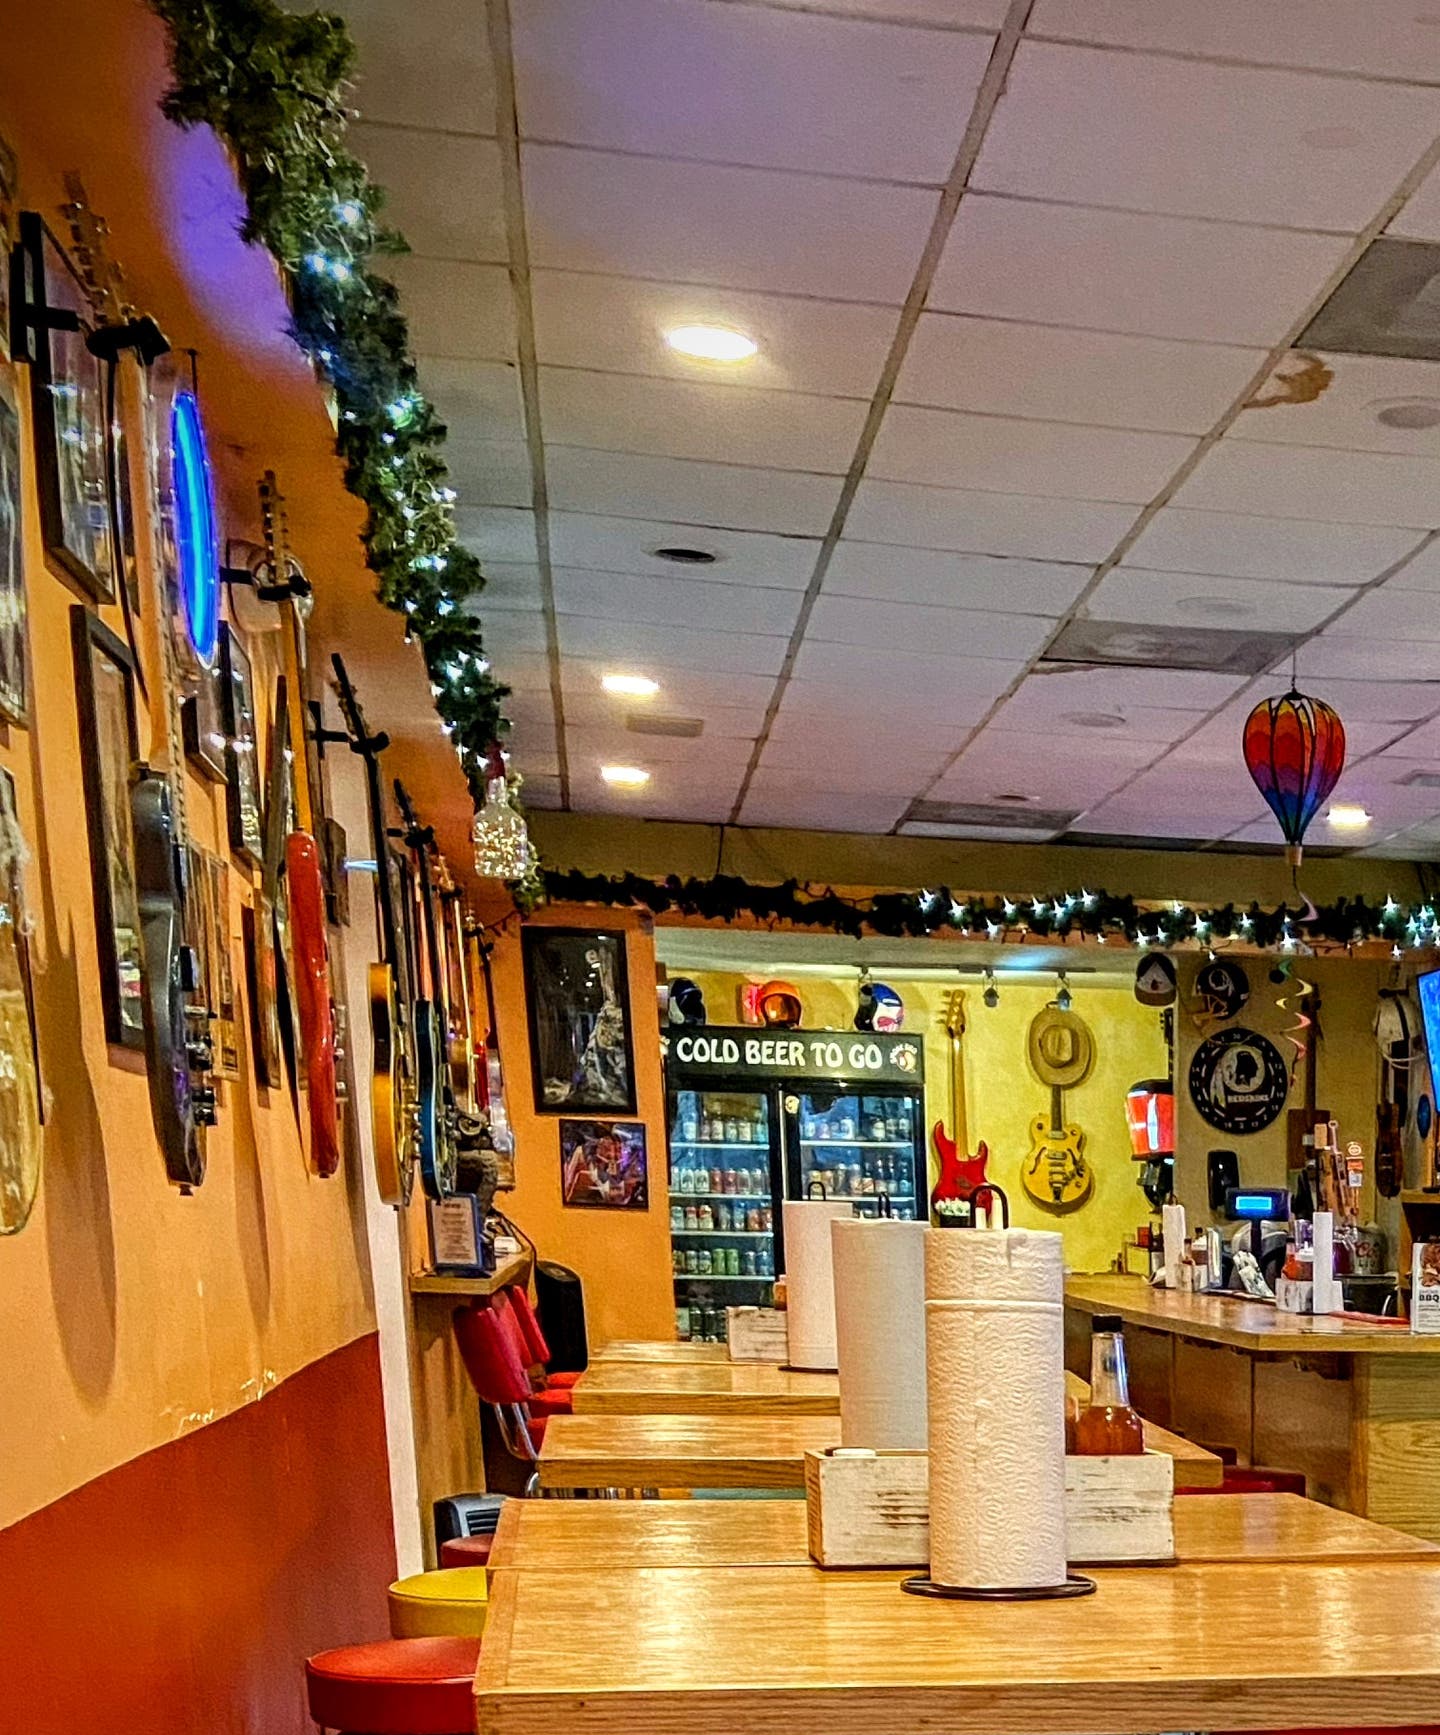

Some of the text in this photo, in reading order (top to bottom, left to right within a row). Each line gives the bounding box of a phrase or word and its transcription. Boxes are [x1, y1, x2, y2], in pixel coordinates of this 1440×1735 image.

[676, 1036, 739, 1063] COLD
[745, 1040, 805, 1067] BEER
[810, 1044, 843, 1068] TO
[848, 1045, 882, 1069] GO
[1419, 1294, 1440, 1302] BBQ
